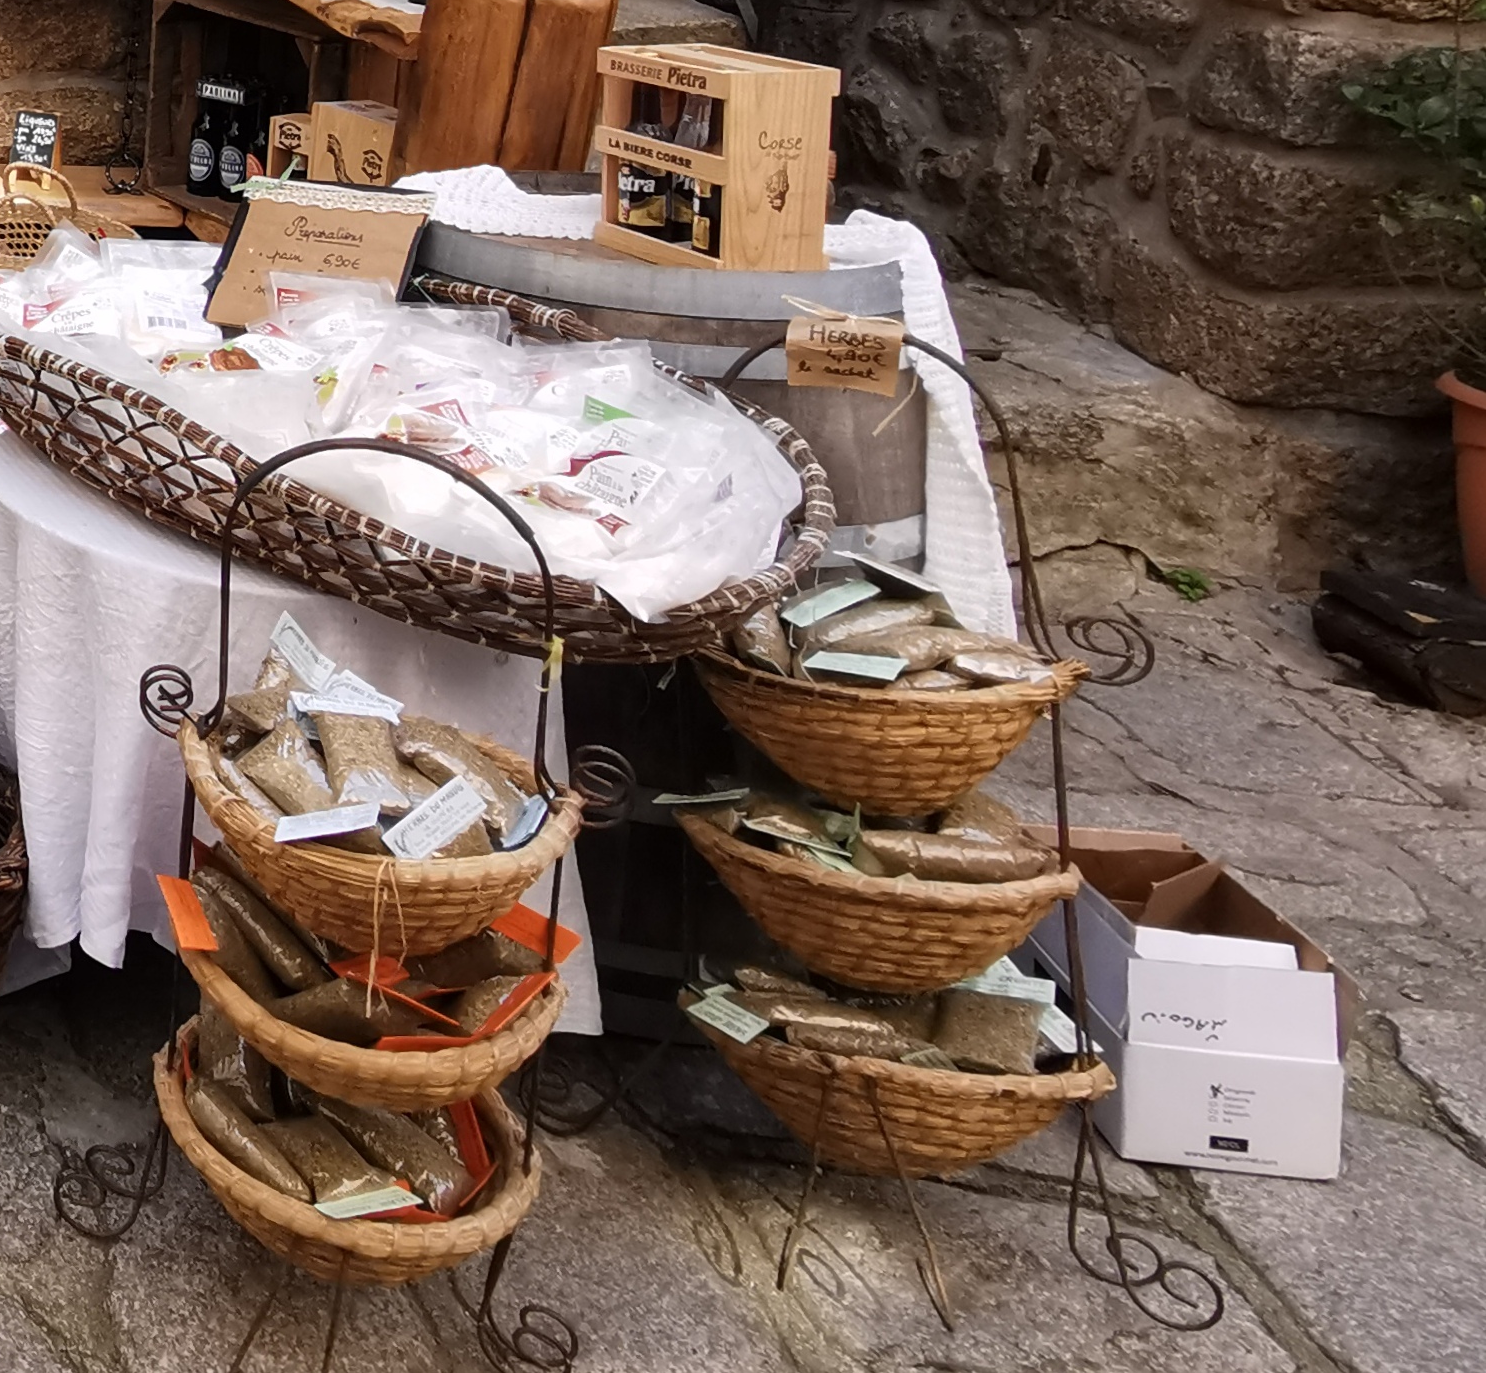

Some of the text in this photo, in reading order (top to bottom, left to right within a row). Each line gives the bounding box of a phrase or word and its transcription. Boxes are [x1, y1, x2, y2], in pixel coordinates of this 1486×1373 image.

[610, 59, 707, 90] BRASSERIE Pietra
[608, 137, 621, 151] LA
[656, 150, 692, 169] CORSE
[758, 130, 803, 151] Corse
[51, 308, 92, 324] Crêpes
[810, 324, 886, 350] HERBES
